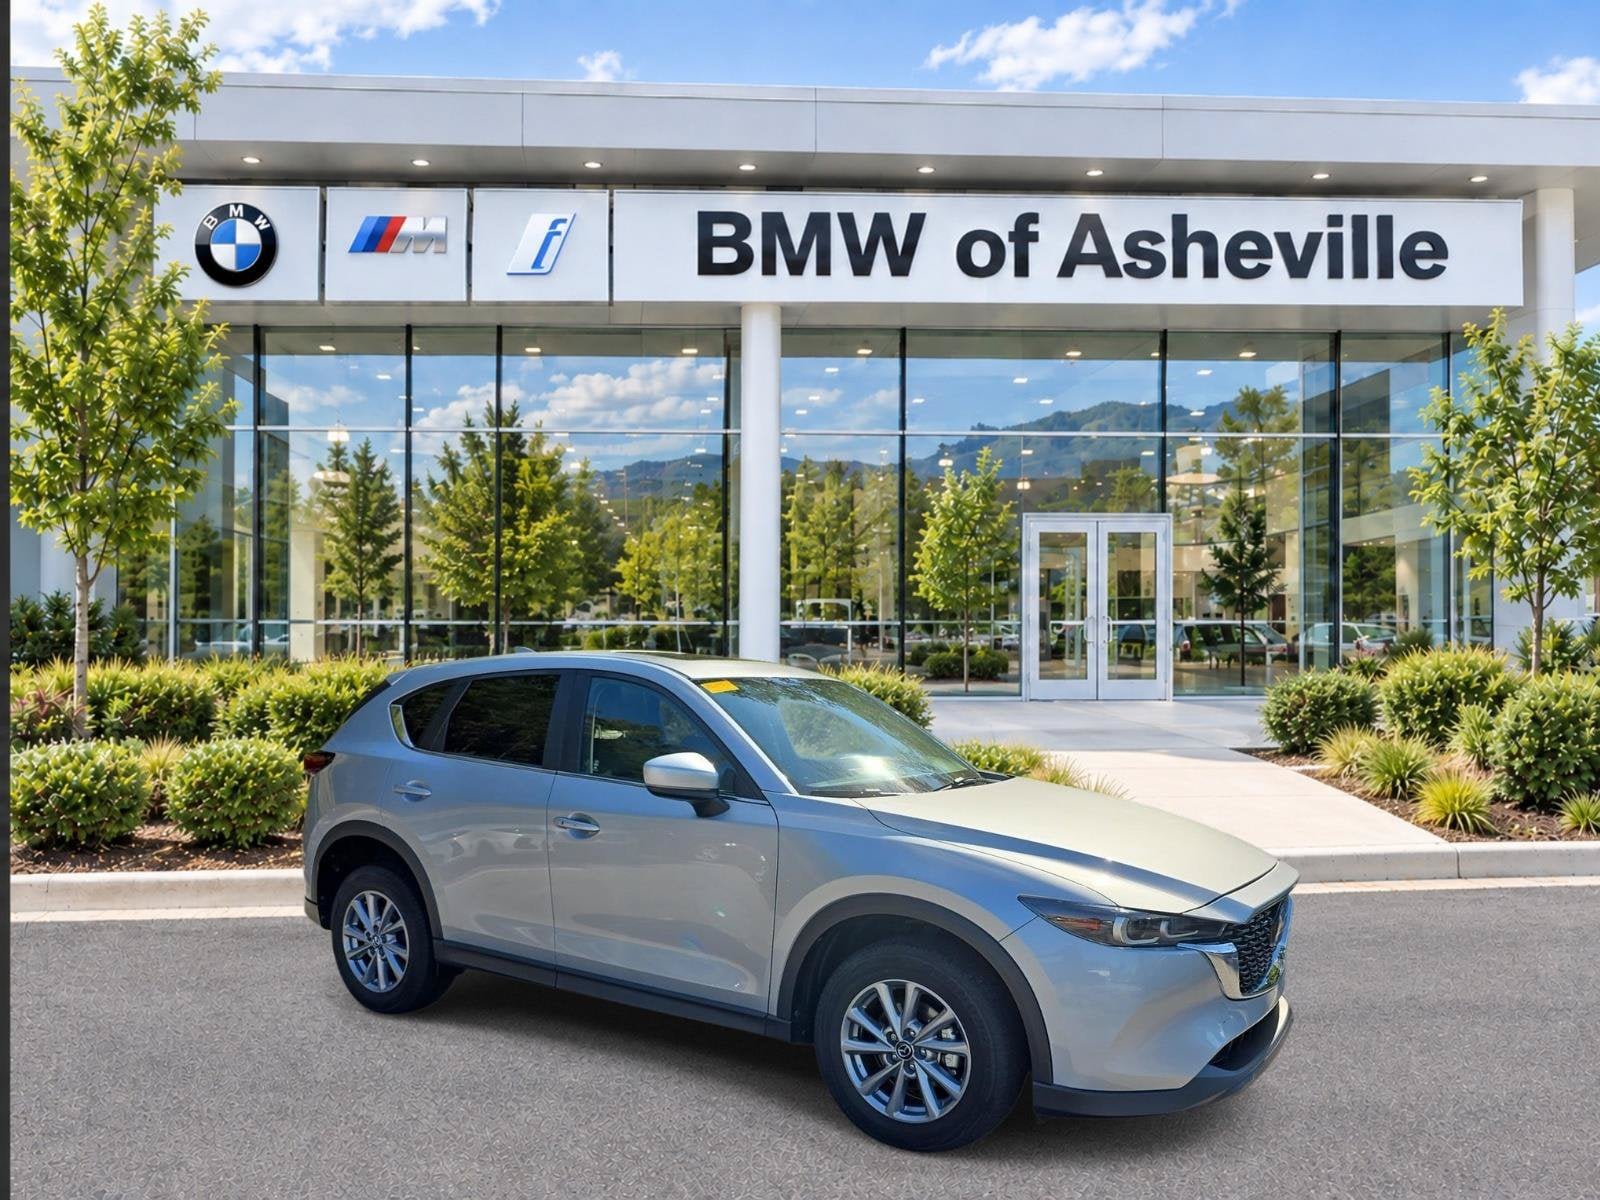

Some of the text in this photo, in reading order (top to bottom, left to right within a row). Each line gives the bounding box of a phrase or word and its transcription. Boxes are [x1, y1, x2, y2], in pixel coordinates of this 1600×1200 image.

[202, 204, 271, 230] BMW
[697, 210, 1449, 280] BMW of Asheville
